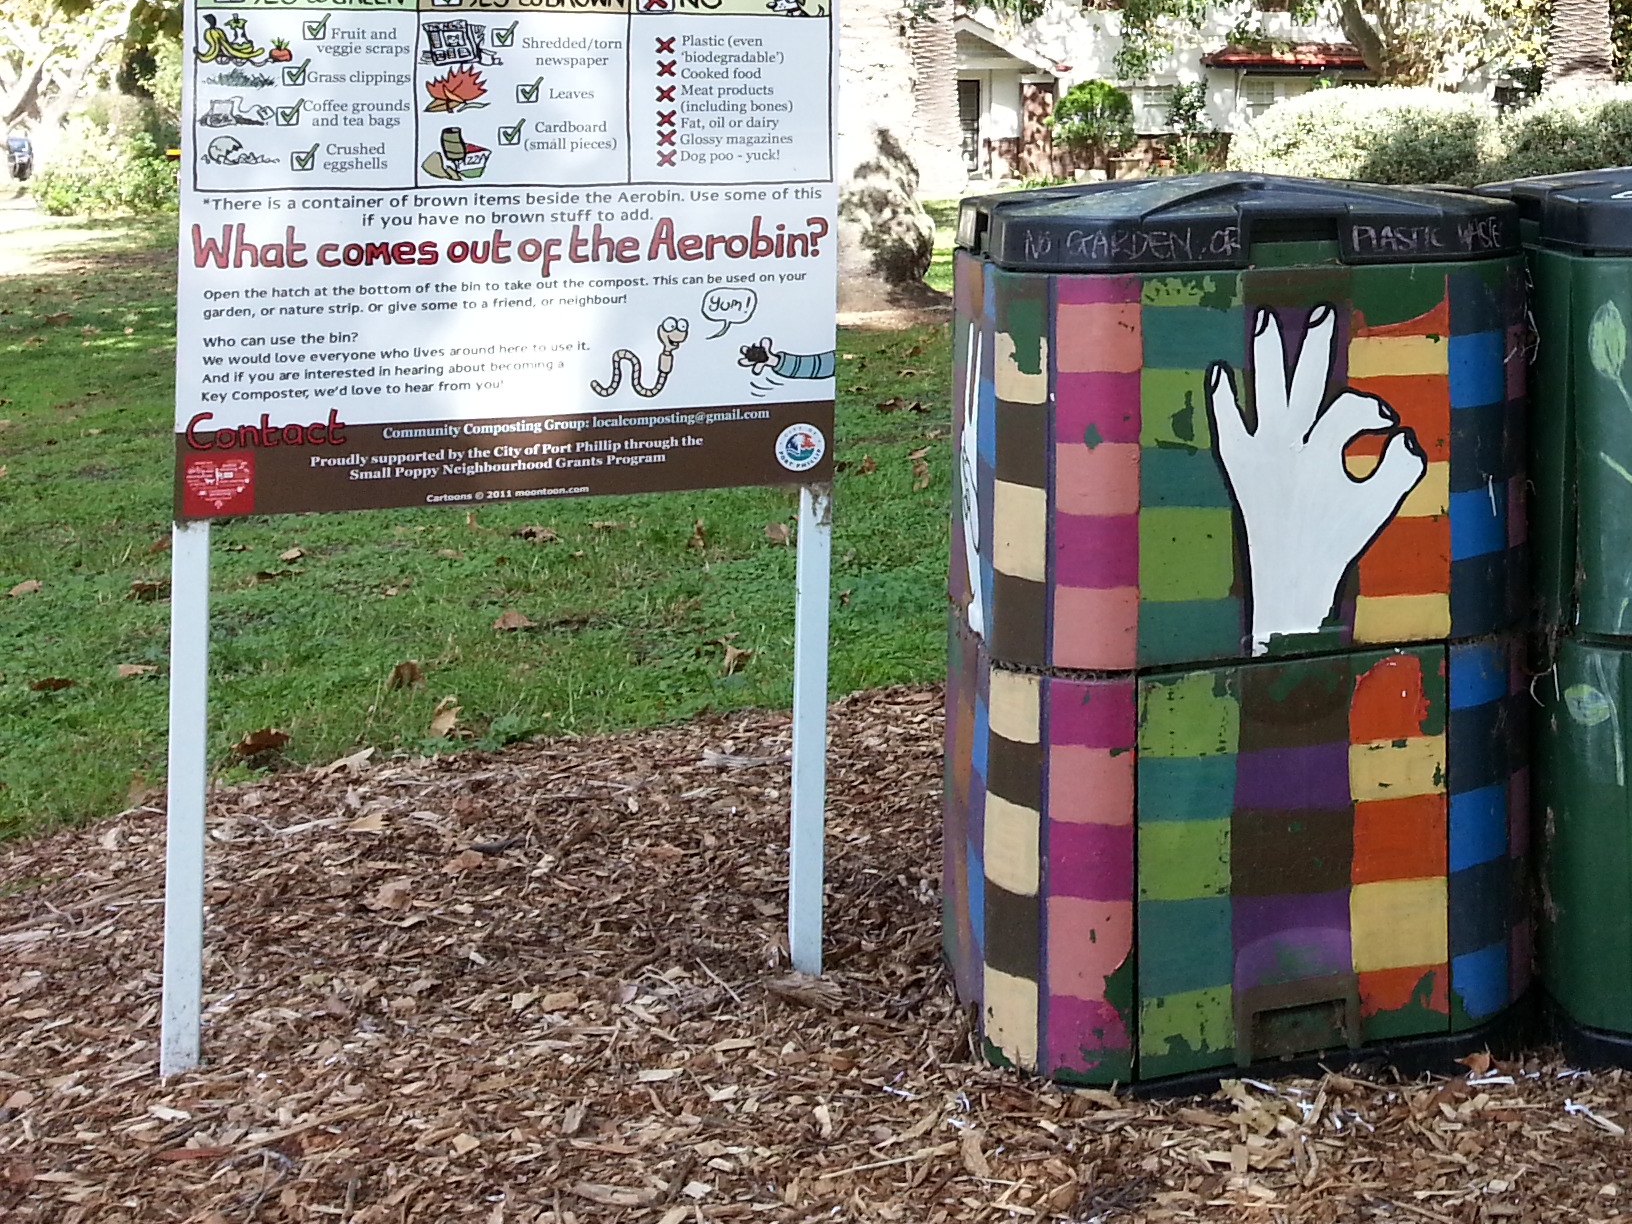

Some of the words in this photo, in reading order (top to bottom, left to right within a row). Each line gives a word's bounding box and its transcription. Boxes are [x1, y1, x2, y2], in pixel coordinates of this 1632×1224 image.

[332, 28, 366, 39] Fruit
[371, 28, 396, 39] and
[522, 37, 622, 50] Shredded/torn
[683, 35, 724, 46] Plastic
[728, 36, 762, 48] (even
[317, 42, 361, 56] veggie
[366, 45, 411, 58] scraps
[536, 58, 608, 68] newspaper
[307, 71, 346, 85] Grass
[350, 71, 411, 87] clippings
[681, 68, 729, 79] Cooked
[734, 68, 761, 79] food
[550, 88, 594, 99] Leaves
[681, 85, 713, 95] Meat
[718, 84, 773, 98] products
[303, 100, 348, 113] Coffee
[352, 101, 411, 115] grounds
[681, 100, 747, 114] (including
[751, 100, 793, 112] bones)
[312, 114, 338, 126] and
[343, 116, 363, 126] tea
[369, 114, 400, 129] bags
[535, 121, 607, 133] Cardboard
[681, 118, 704, 129] Fat,
[709, 117, 724, 128] oil
[729, 120, 743, 128] or
[746, 117, 779, 130] dairy
[524, 138, 566, 151] (small
[571, 138, 617, 152] pieces)
[680, 133, 723, 147] Glossy
[727, 133, 793, 146] magazines
[326, 142, 385, 155] Crushed
[681, 151, 706, 163] Dog
[710, 153, 733, 164] poo
[746, 149, 779, 163] yuck!
[324, 158, 387, 172] eggshells
[268, 196, 280, 209] is
[288, 199, 295, 210] a
[302, 195, 383, 209] container
[390, 194, 408, 207] of
[414, 194, 467, 208] brown
[474, 192, 520, 206] items
[526, 191, 579, 205] beside
[586, 191, 612, 204] the
[618, 189, 684, 203] Aerobin.
[691, 190, 719, 202] Use
[725, 191, 766, 201] some
[772, 187, 789, 200] of
[794, 187, 821, 200] this
[363, 213, 374, 226] if
[381, 215, 412, 229] you
[419, 212, 459, 225] have
[465, 214, 485, 224] no
[492, 211, 544, 224] brown
[551, 209, 592, 223] stuff
[597, 209, 608, 221] to
[621, 208, 653, 221] add.
[192, 223, 307, 270] What
[316, 240, 438, 266] comes
[446, 228, 512, 264] out
[518, 237, 562, 278] of
[568, 224, 641, 264] the
[647, 215, 829, 261] Aerobin?
[708, 295, 751, 314] Yum!
[203, 336, 235, 347] Who
[241, 337, 265, 347] can
[271, 336, 295, 345] use
[301, 333, 324, 344] the
[330, 331, 358, 343] bin?
[186, 408, 347, 450] Contact
[383, 423, 461, 439] Community
[464, 419, 542, 436] Composting
[544, 419, 589, 432] Group:
[593, 408, 769, 428] localcomposting@gmail.com
[311, 453, 368, 467] Proudly
[371, 449, 444, 466] supported
[449, 448, 464, 462] by
[468, 447, 490, 458] the
[494, 446, 522, 458] City
[524, 443, 540, 456] of
[542, 443, 571, 455] Port
[576, 439, 621, 453] Phillip
[624, 436, 678, 450] through
[682, 435, 703, 447] the
[350, 466, 390, 480] Small
[396, 467, 439, 480] Poppy
[443, 457, 552, 475] Neighbourhood
[556, 456, 603, 468] Grants
[607, 454, 665, 466] Program
